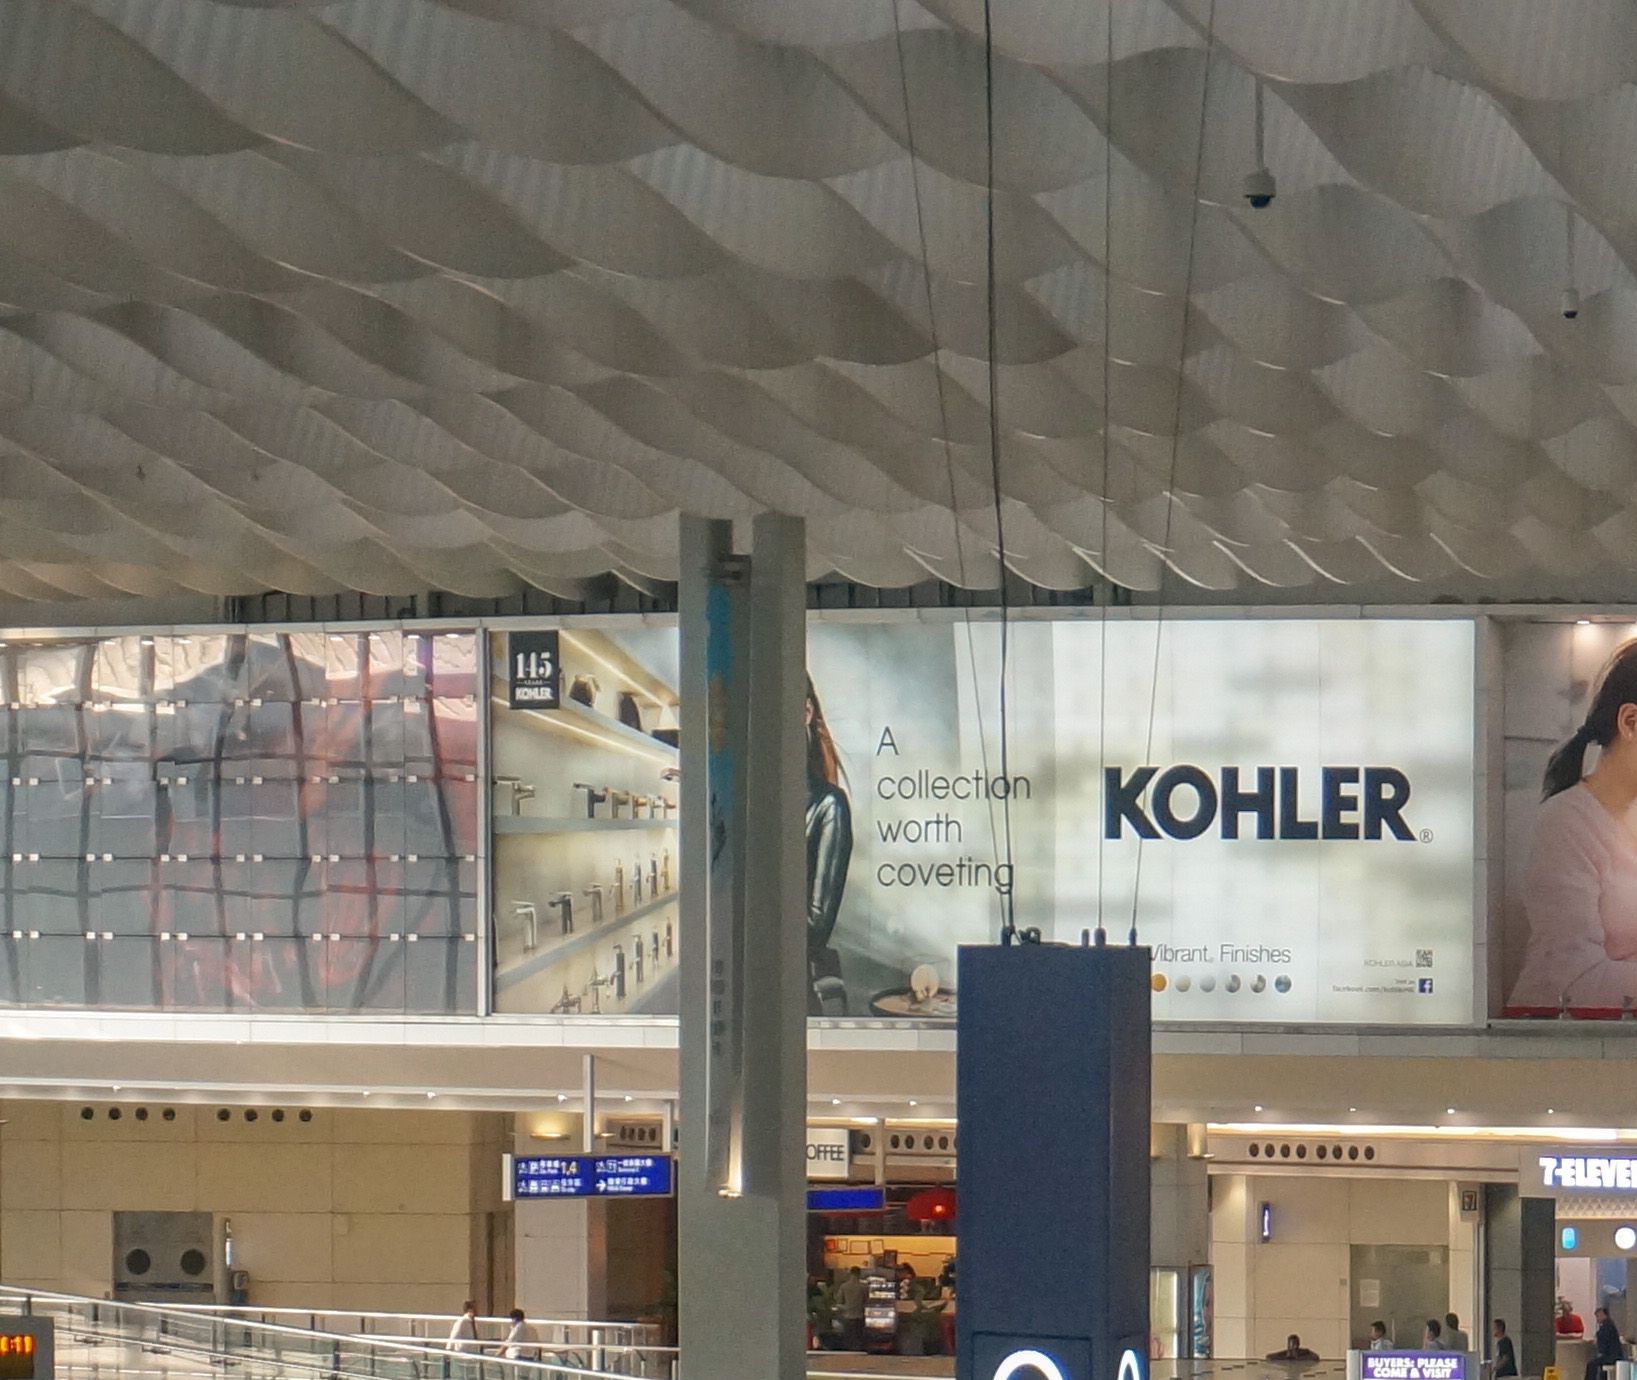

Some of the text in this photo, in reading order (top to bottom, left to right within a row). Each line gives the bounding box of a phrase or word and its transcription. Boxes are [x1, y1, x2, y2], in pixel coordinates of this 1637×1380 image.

[516, 651, 552, 679] 145
[515, 687, 554, 701] KOHLER
[877, 727, 899, 756] A
[877, 769, 1032, 800] collection
[1105, 765, 1417, 840] KOHLER
[877, 813, 962, 843] worth
[877, 858, 1014, 894] coveting
[1220, 944, 1291, 963] Finishes
[806, 1144, 844, 1161] OFFEE
[1367, 1358, 1458, 1369] BUYERS: PLEASE
[1373, 1368, 1407, 1378] COME
[1423, 1368, 1452, 1378] VISIT
